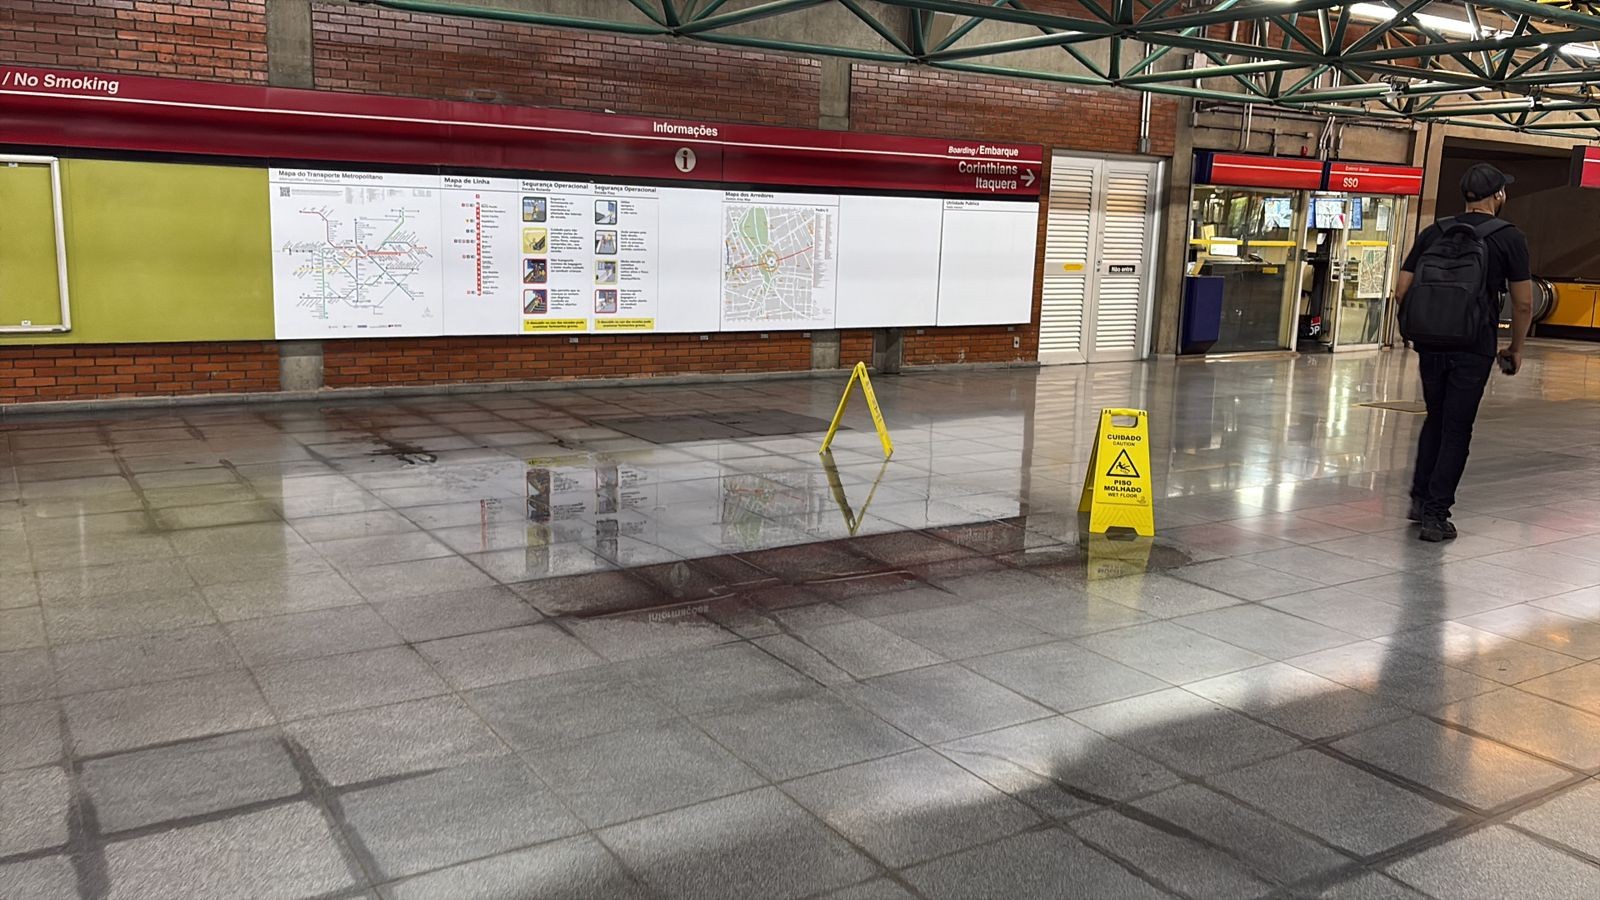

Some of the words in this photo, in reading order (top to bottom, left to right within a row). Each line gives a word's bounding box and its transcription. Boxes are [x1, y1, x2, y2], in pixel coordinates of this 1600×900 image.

[14, 72, 39, 87] No
[43, 73, 120, 95] Smoking
[653, 121, 719, 138] Informações
[958, 161, 1018, 175] Corinthians
[278, 170, 297, 178] Mapa
[306, 171, 341, 179] Transporte
[341, 173, 384, 181] Metropolitano
[444, 177, 463, 185] Mapa
[521, 181, 553, 189] Segurança
[554, 182, 589, 190] Operacional
[975, 176, 1017, 192] Itaquera
[1343, 177, 1359, 188] SSO
[594, 184, 623, 193] Segurança
[1107, 434, 1142, 442] CUIDADO
[1103, 485, 1142, 493] MOLHADO
